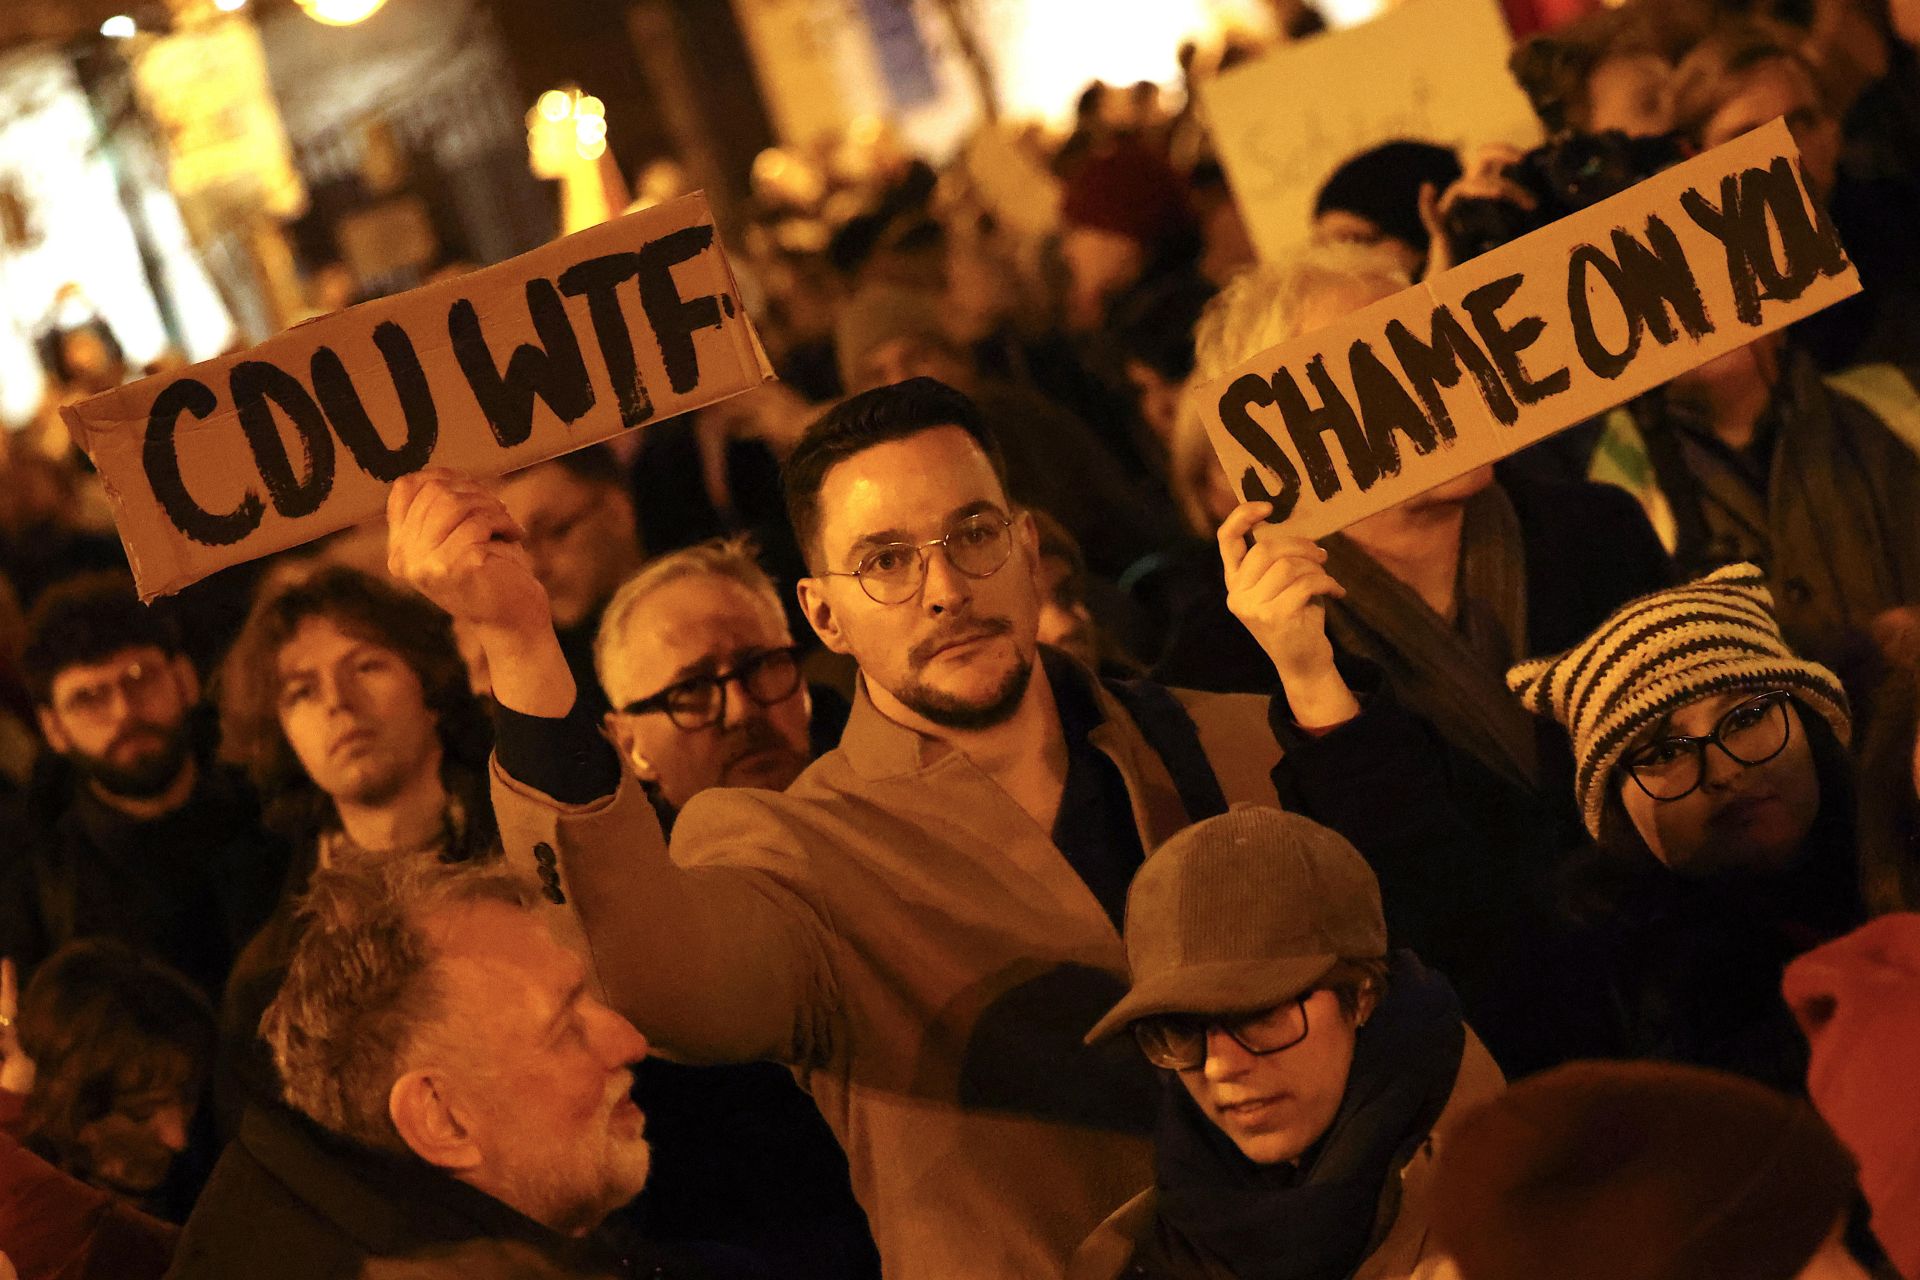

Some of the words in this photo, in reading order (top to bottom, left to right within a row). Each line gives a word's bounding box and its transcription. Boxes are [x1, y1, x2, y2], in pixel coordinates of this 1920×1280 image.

[142, 320, 438, 546] CDU
[448, 224, 735, 448] WTF
[1219, 273, 1571, 524] SHAME
[1568, 211, 1716, 380] ON
[1679, 155, 1849, 327] YOU
